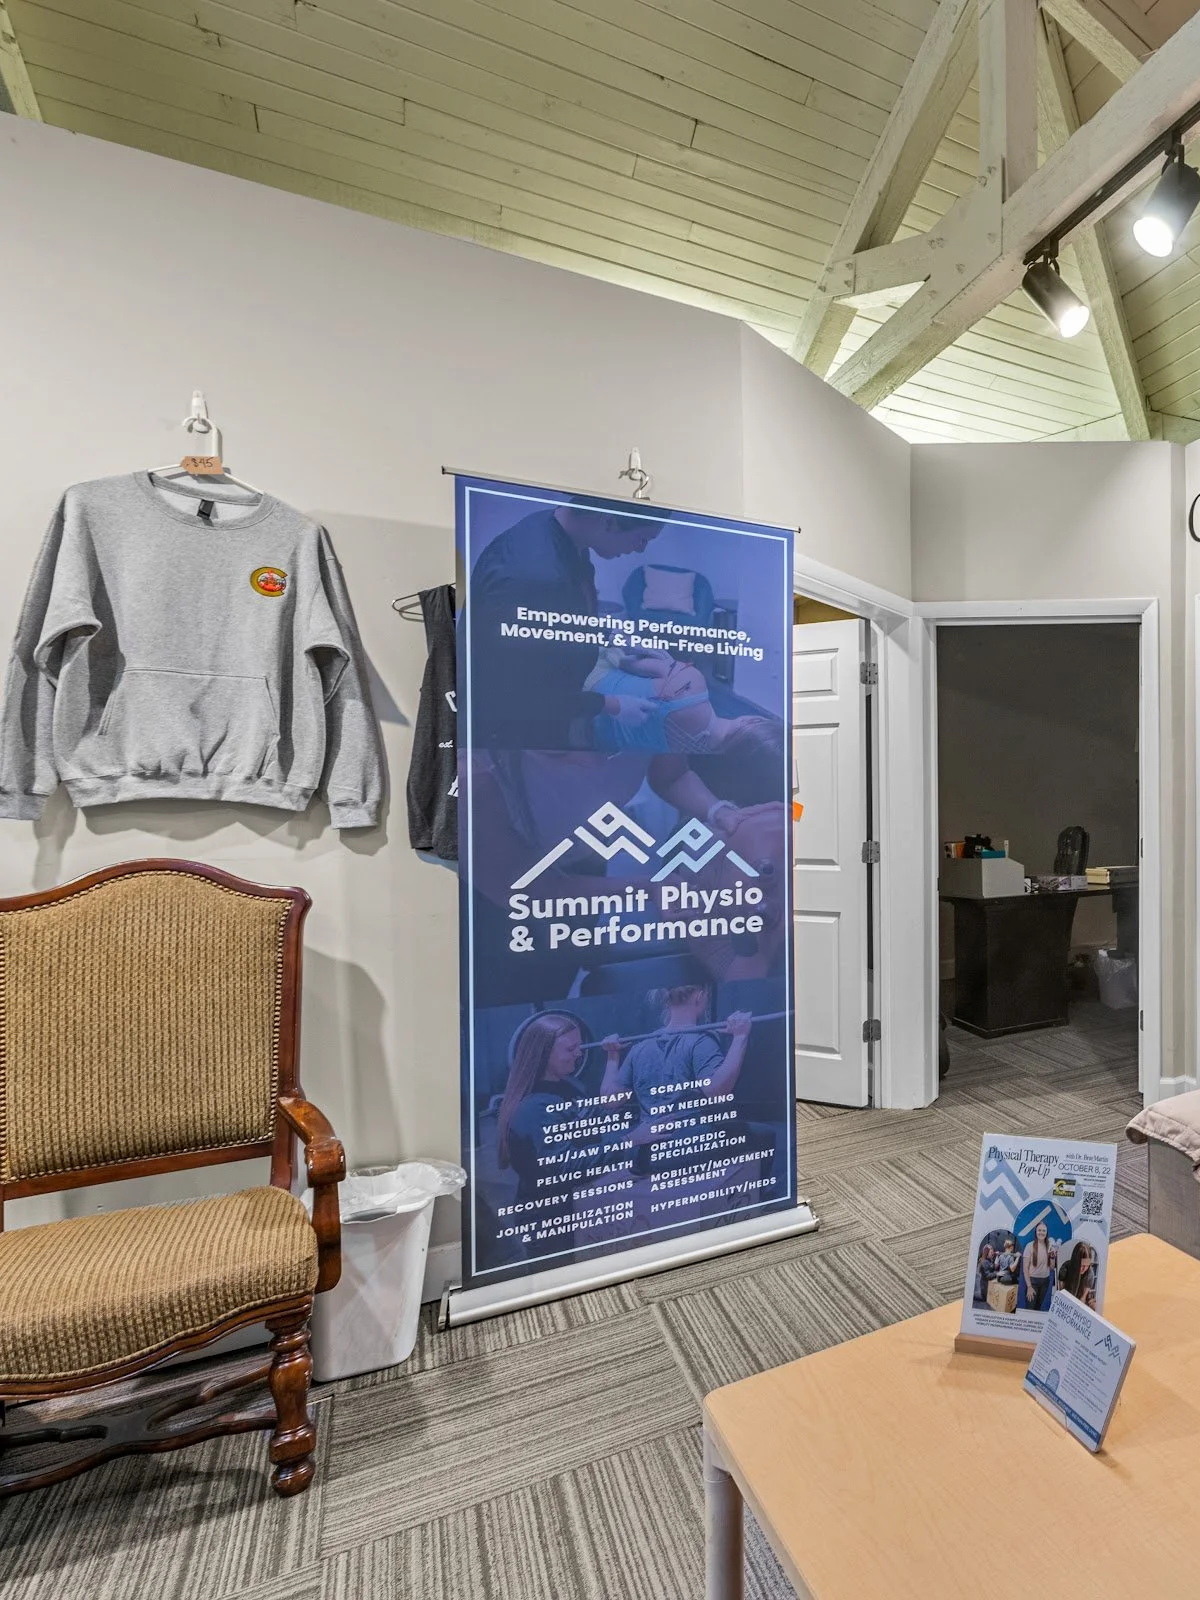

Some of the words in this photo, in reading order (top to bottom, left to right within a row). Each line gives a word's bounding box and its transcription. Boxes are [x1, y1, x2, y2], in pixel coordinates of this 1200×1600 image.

[517, 607, 634, 634] Empowering
[639, 619, 751, 642] Performance,
[501, 622, 609, 648] Movement,
[613, 635, 627, 647] &
[631, 636, 714, 654] Pain-Free
[717, 642, 763, 661] Living
[508, 886, 648, 920] Summit
[661, 881, 763, 913] Physio
[509, 926, 535, 952] &
[550, 915, 763, 949] Performance
[650, 1078, 711, 1095] SCRAPING
[546, 1101, 573, 1113] CUP
[577, 1091, 633, 1108] THERAPY
[650, 1103, 674, 1116] DRY
[678, 1093, 734, 1111] NEEDLING
[543, 1114, 621, 1135] VESTIBULAR
[624, 1111, 633, 1120] &
[544, 1122, 630, 1144] CONCUSSION
[650, 1118, 696, 1134] SPORTS
[700, 1110, 737, 1124] REHAB
[537, 1147, 600, 1167] TMJ/JAW
[603, 1140, 633, 1153] PAIN
[650, 1130, 726, 1152] ORTHOPEDIC
[651, 1136, 746, 1162] SPECIALIZATION
[651, 1149, 775, 1182] MOBILITY/MOVEMENT
[988, 1146, 1022, 1162] Physical
[1024, 1149, 1060, 1167] Therapy
[1058, 1162, 1093, 1173] OCTOBER
[1102, 1166, 1110, 1175] 22
[537, 1170, 582, 1187] PELVIC
[586, 1160, 633, 1177] HEALTH
[651, 1168, 727, 1192] ASSESSMENT
[1018, 1162, 1050, 1179] Pop-Up
[498, 1193, 569, 1216] RECOVERY
[573, 1180, 633, 1200] SESSIONS
[651, 1177, 777, 1212] HYPERMOBILITY/HEDS
[496, 1222, 537, 1238] JOINT
[541, 1201, 633, 1228] MOBILIZATION
[522, 1233, 532, 1243] &
[537, 1210, 633, 1240] MANIPULATION
[1055, 1308, 1091, 1341] PERFORMANCE
[1073, 1307, 1092, 1329] PHYSIO
